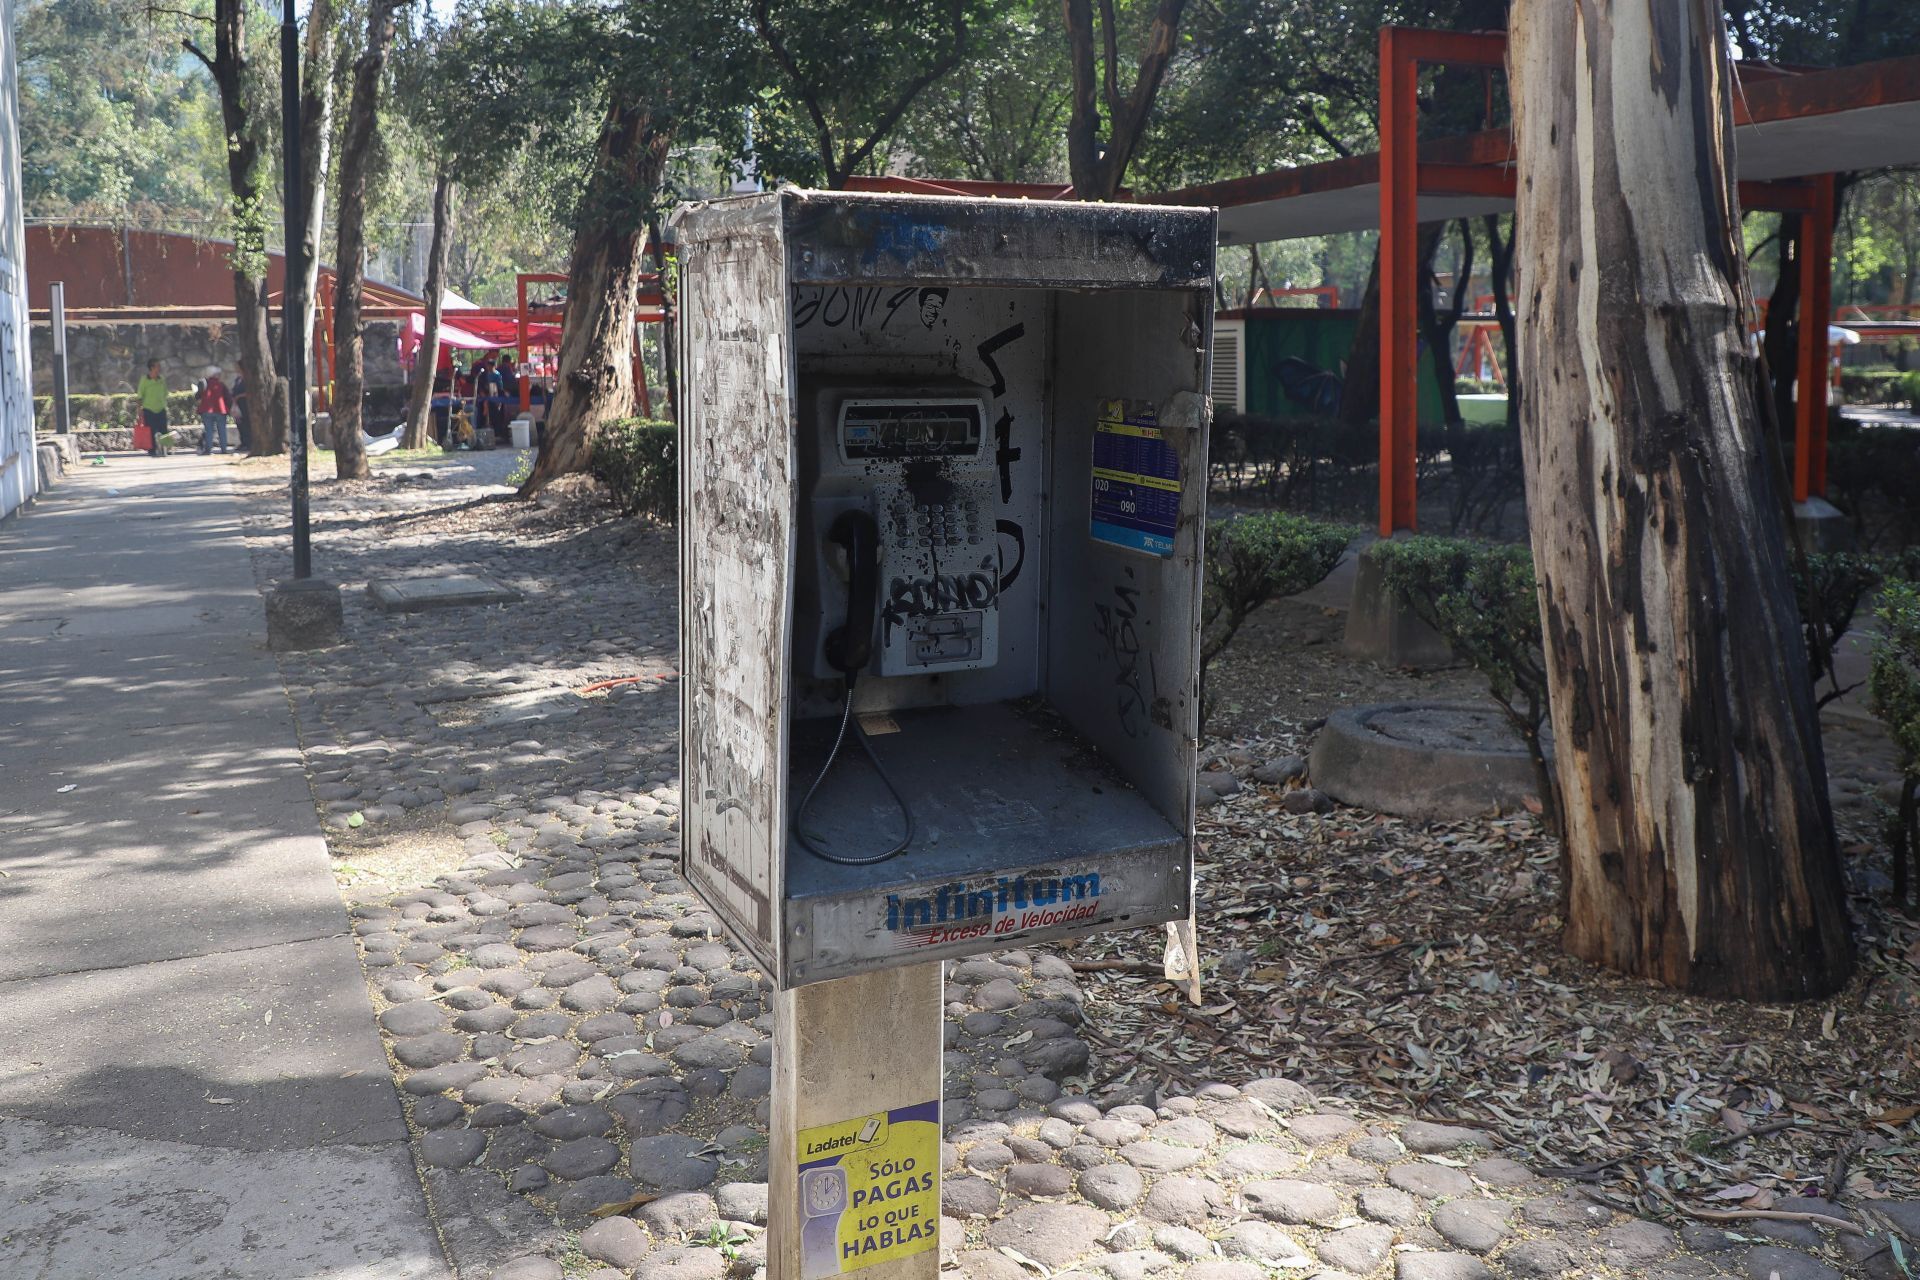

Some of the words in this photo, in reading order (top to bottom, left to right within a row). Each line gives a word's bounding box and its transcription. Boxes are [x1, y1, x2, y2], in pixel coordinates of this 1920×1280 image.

[1095, 478, 1109, 492] 020
[1121, 500, 1136, 514] 090
[928, 922, 991, 944] Exceso
[994, 917, 1015, 935] de
[1020, 901, 1099, 930] Velocidad
[806, 1132, 857, 1155] Ladatel
[869, 1158, 916, 1180] SÓLO
[853, 1172, 933, 1208] PAGAS
[859, 1215, 879, 1232] LO
[884, 1205, 919, 1227] QUE
[843, 1219, 935, 1259] HABLAS
